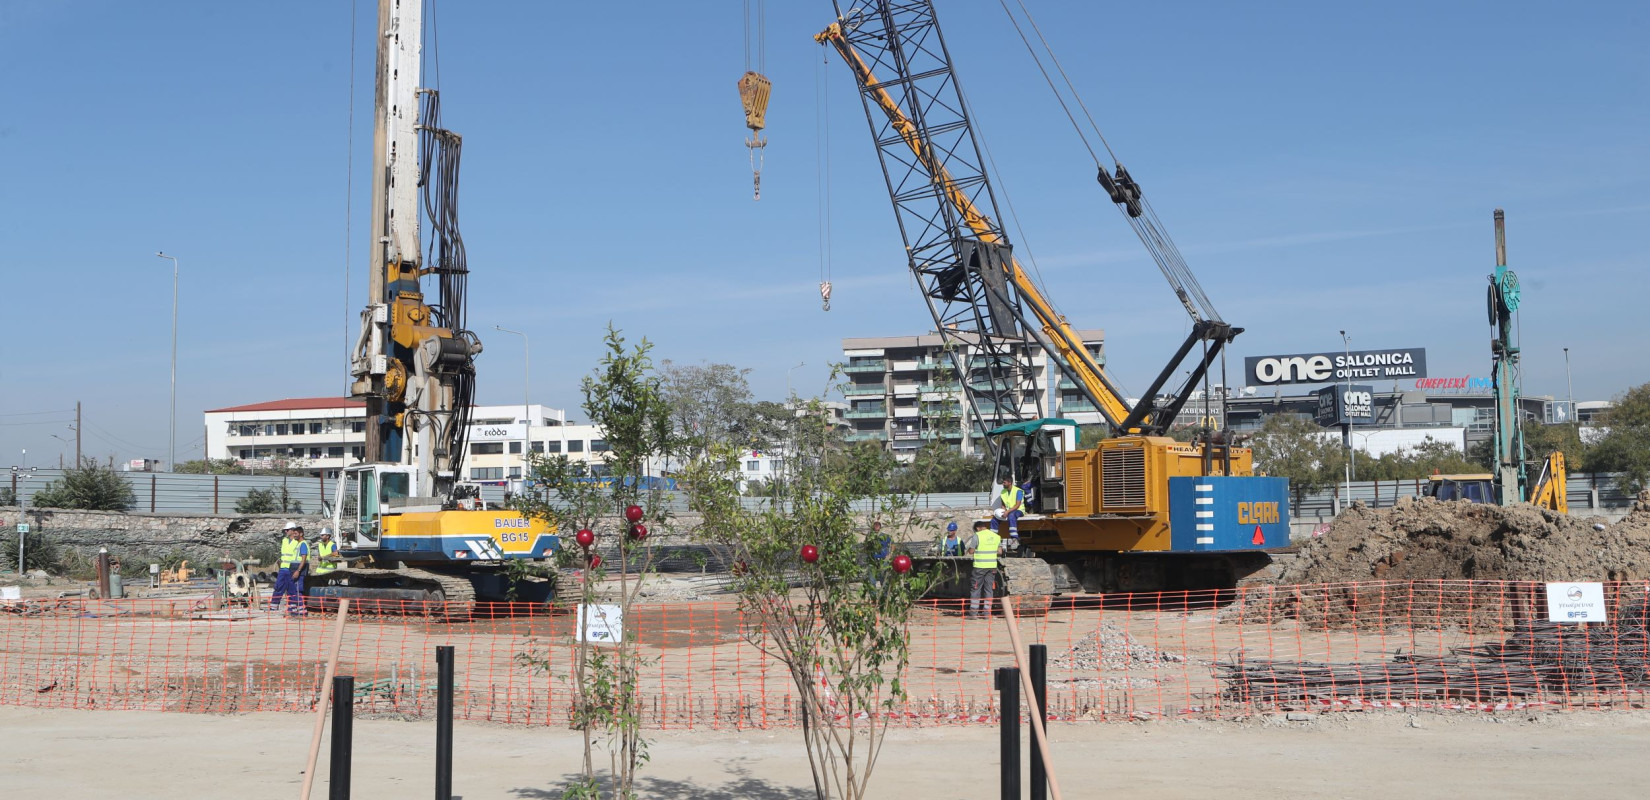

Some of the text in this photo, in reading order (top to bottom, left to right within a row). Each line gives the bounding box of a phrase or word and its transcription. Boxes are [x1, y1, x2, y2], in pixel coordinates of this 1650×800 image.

[1335, 352, 1413, 367] SALONICA
[1255, 355, 1333, 383] one
[1336, 366, 1416, 378] OUTLET MALL
[1415, 374, 1470, 389] CINEPLEXX
[1343, 391, 1372, 405] one
[1344, 404, 1371, 412] SLONICA
[1237, 501, 1280, 524] CLARK
[494, 518, 531, 528] BAUER
[501, 532, 529, 542] BG 15
